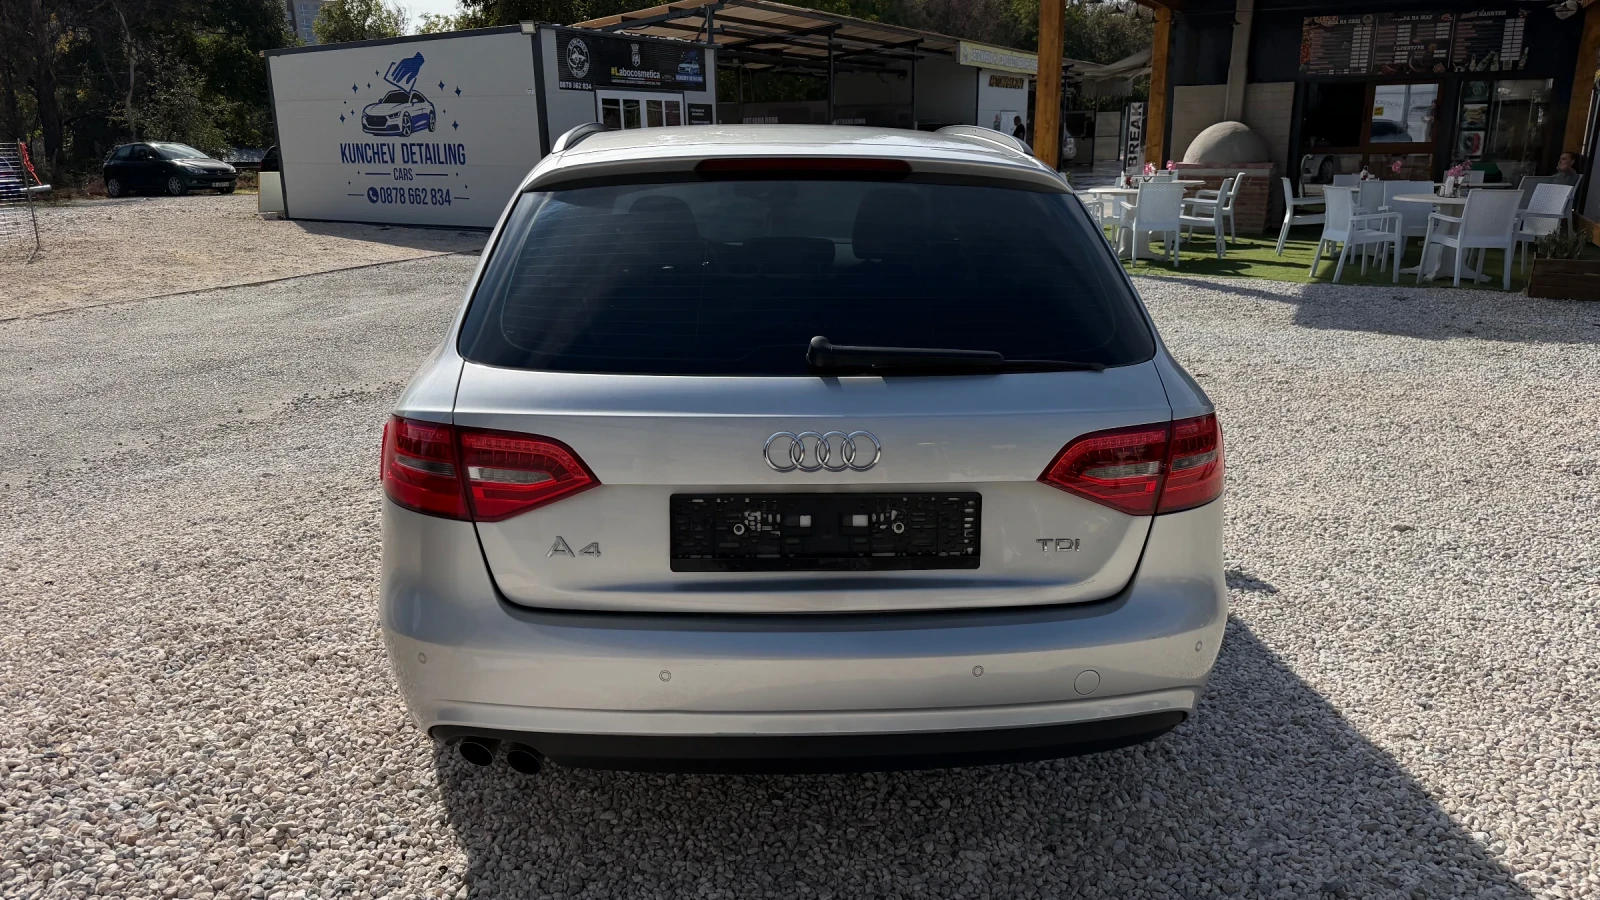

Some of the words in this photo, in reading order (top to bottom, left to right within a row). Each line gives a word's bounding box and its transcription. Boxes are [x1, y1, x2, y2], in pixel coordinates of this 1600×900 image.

[610, 66, 661, 79] #Labocosmetica
[1127, 103, 1143, 168] BREAK
[340, 143, 395, 164] KUNCHEV
[401, 143, 466, 165] DETAILING
[393, 168, 413, 181] CARS
[380, 187, 405, 204] 0878
[408, 188, 428, 205] 662
[430, 188, 452, 206] 834
[546, 536, 601, 558] A4
[1036, 538, 1081, 552] TDI
